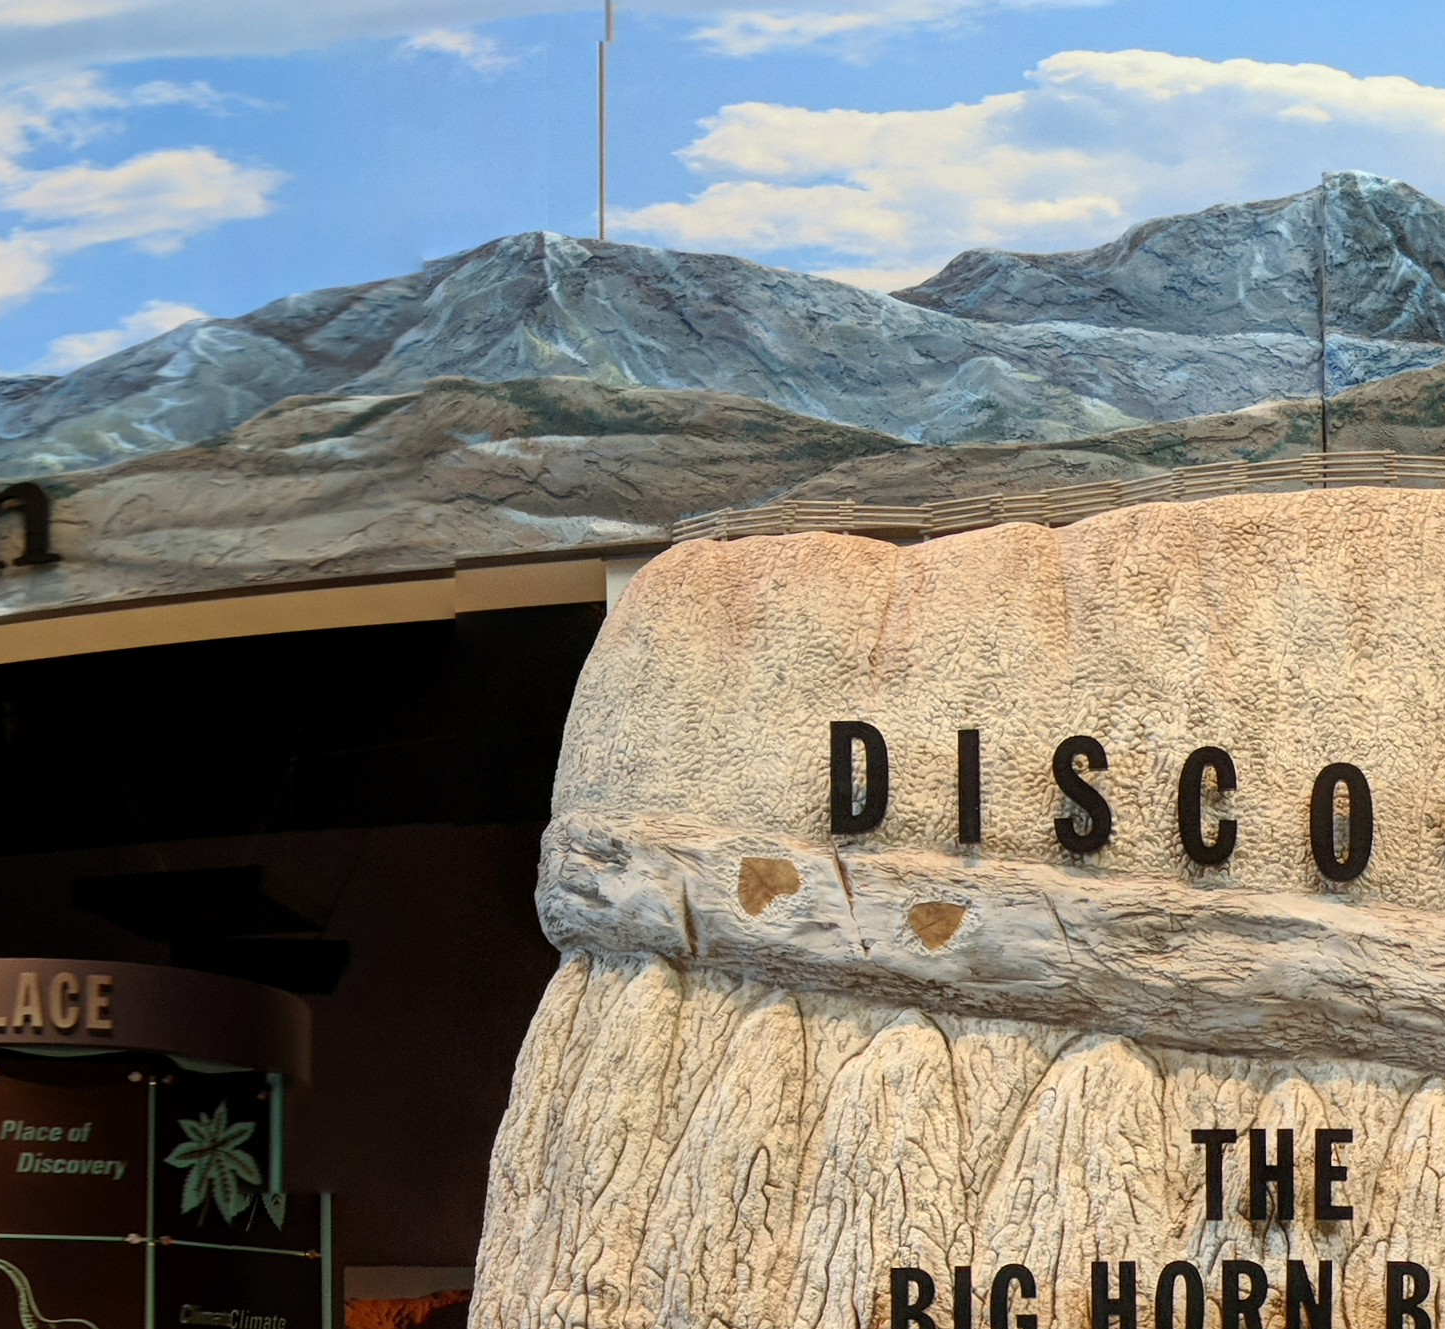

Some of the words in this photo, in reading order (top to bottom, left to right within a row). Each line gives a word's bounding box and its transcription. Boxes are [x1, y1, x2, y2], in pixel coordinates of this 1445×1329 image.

[0, 1120, 63, 1143] Place
[68, 1122, 92, 1142] of
[16, 1152, 127, 1180] Discovery
[1190, 1128, 1353, 1221] THE
